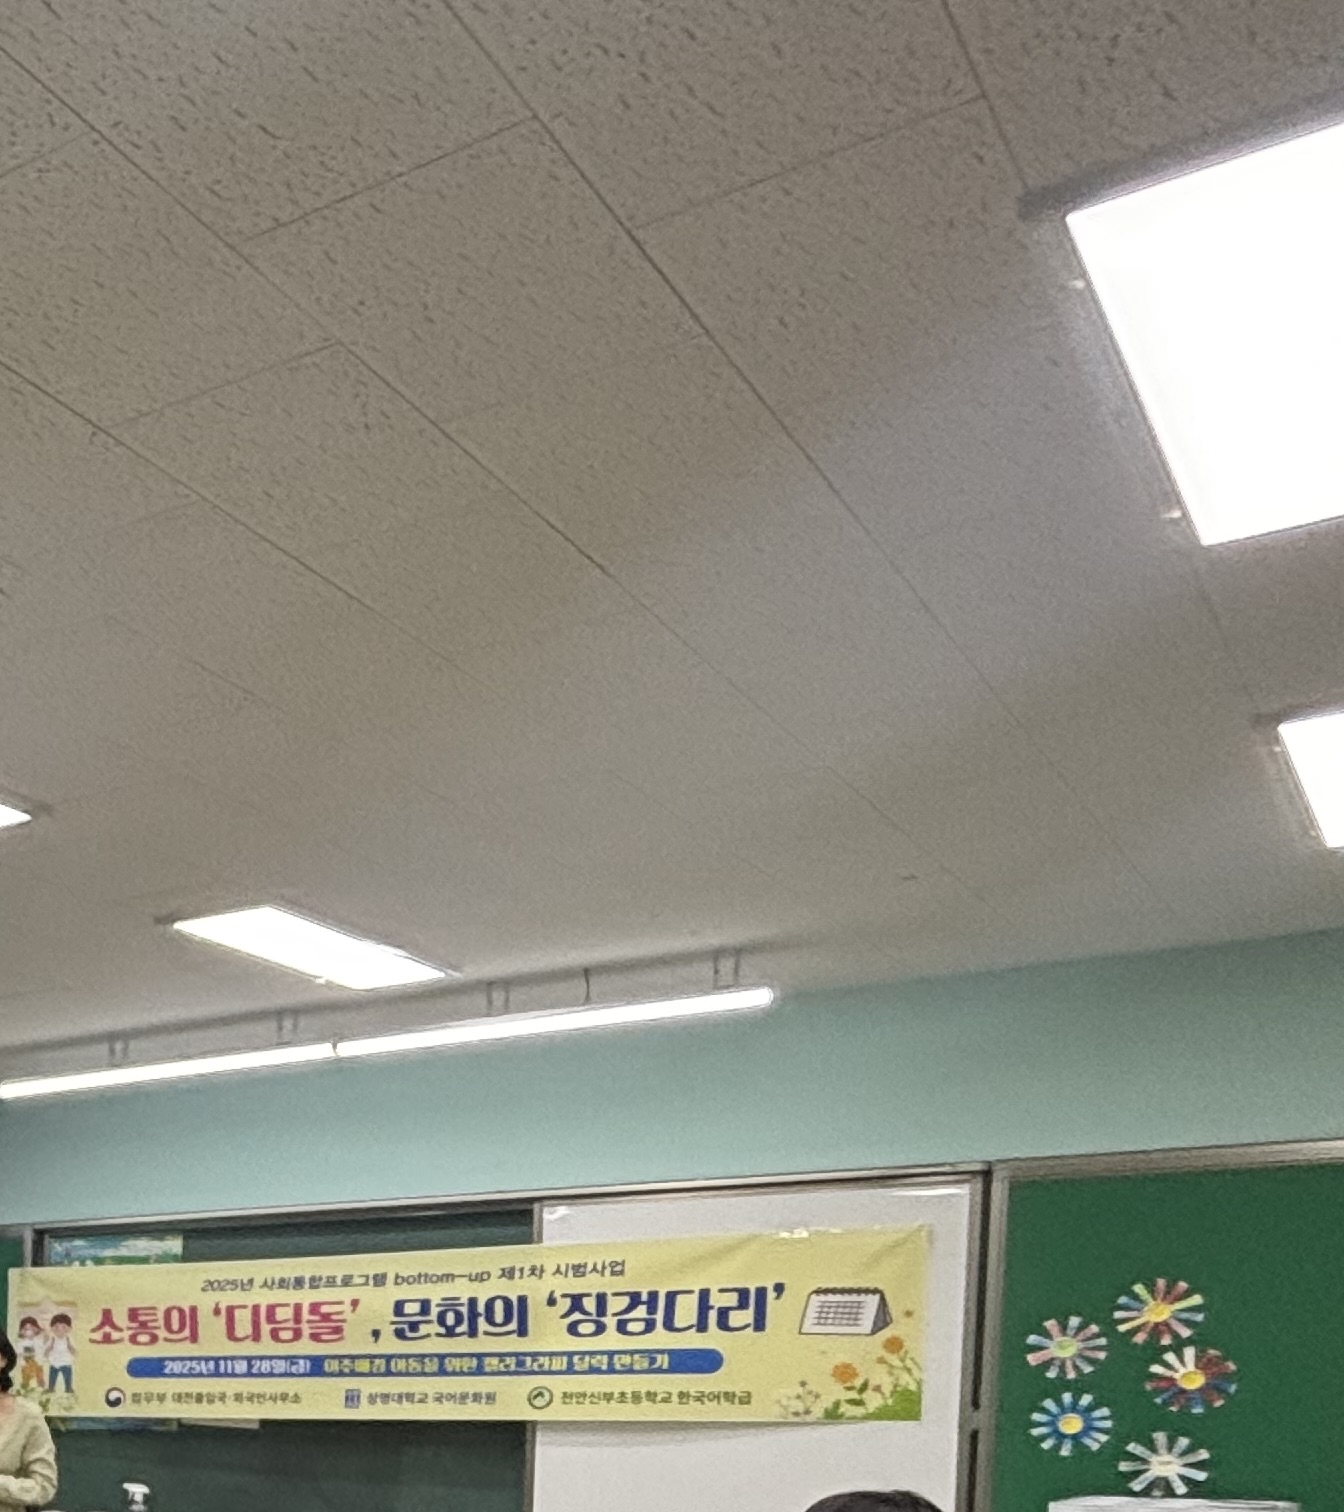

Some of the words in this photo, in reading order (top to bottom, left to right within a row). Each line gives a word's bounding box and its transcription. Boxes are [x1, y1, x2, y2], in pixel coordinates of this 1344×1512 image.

[201, 1277, 254, 1293] 2025년
[259, 1272, 388, 1292] 사회통합프로그램
[393, 1270, 492, 1287] bottom-up
[497, 1263, 547, 1282] 제1차
[552, 1259, 626, 1279] 시범사업
[88, 1304, 200, 1346] 소통의
[163, 1359, 216, 1375] 2025년
[219, 1358, 247, 1375] 11월
[444, 1355, 478, 1373] 위한
[572, 1354, 608, 1372] 달력
[612, 1352, 669, 1371] 만들기
[677, 1390, 753, 1406] 한국어학급
